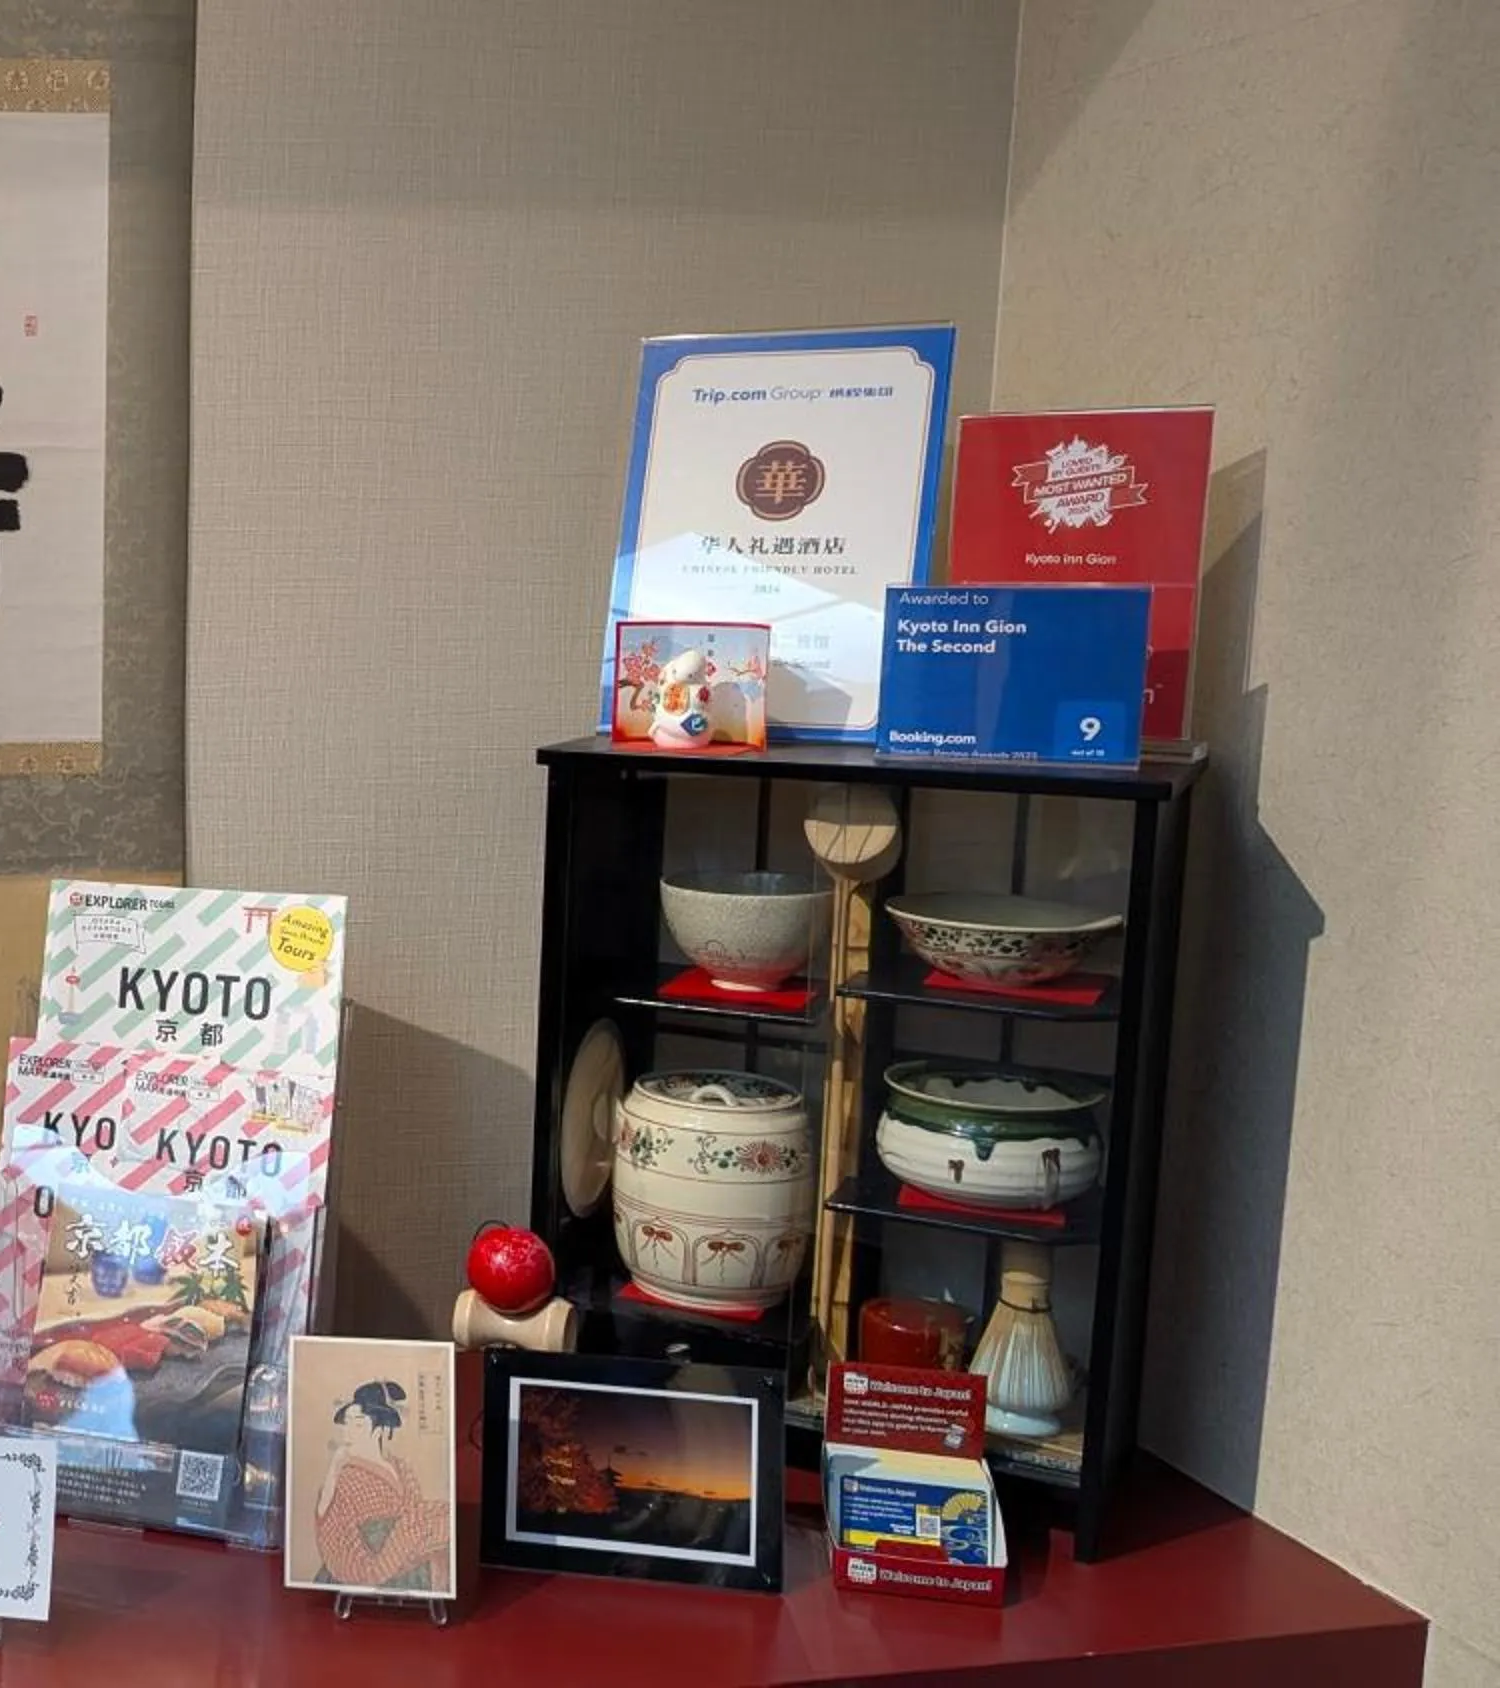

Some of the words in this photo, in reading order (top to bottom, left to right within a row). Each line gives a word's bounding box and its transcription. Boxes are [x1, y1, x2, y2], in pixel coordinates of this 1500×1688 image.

[692, 387, 767, 404] Trip.com
[770, 386, 822, 402] Group
[755, 459, 809, 504] 華
[1034, 481, 1070, 497] MOST
[1070, 473, 1127, 490] WANTED
[1056, 492, 1105, 508] AWARD
[1025, 553, 1061, 565] Kyoto
[1063, 553, 1083, 564] Inn
[1089, 553, 1116, 565] Gion
[743, 565, 808, 575] FRIENDLY
[813, 566, 858, 575] HOTEL
[900, 592, 970, 606] Awarded
[973, 594, 989, 605] to
[897, 620, 949, 636] Kyoto
[953, 620, 980, 633] Inn
[985, 620, 1027, 634] Gion
[897, 640, 927, 652] The
[932, 640, 997, 653] Second
[1080, 717, 1101, 741] 9
[889, 730, 976, 746] Booking.com
[85, 893, 148, 910] EXPLORER
[277, 936, 316, 961] Tours
[117, 966, 272, 1021] KYOTO
[19, 1054, 71, 1069] EXPLORER
[155, 1127, 284, 1178] KYOTO
